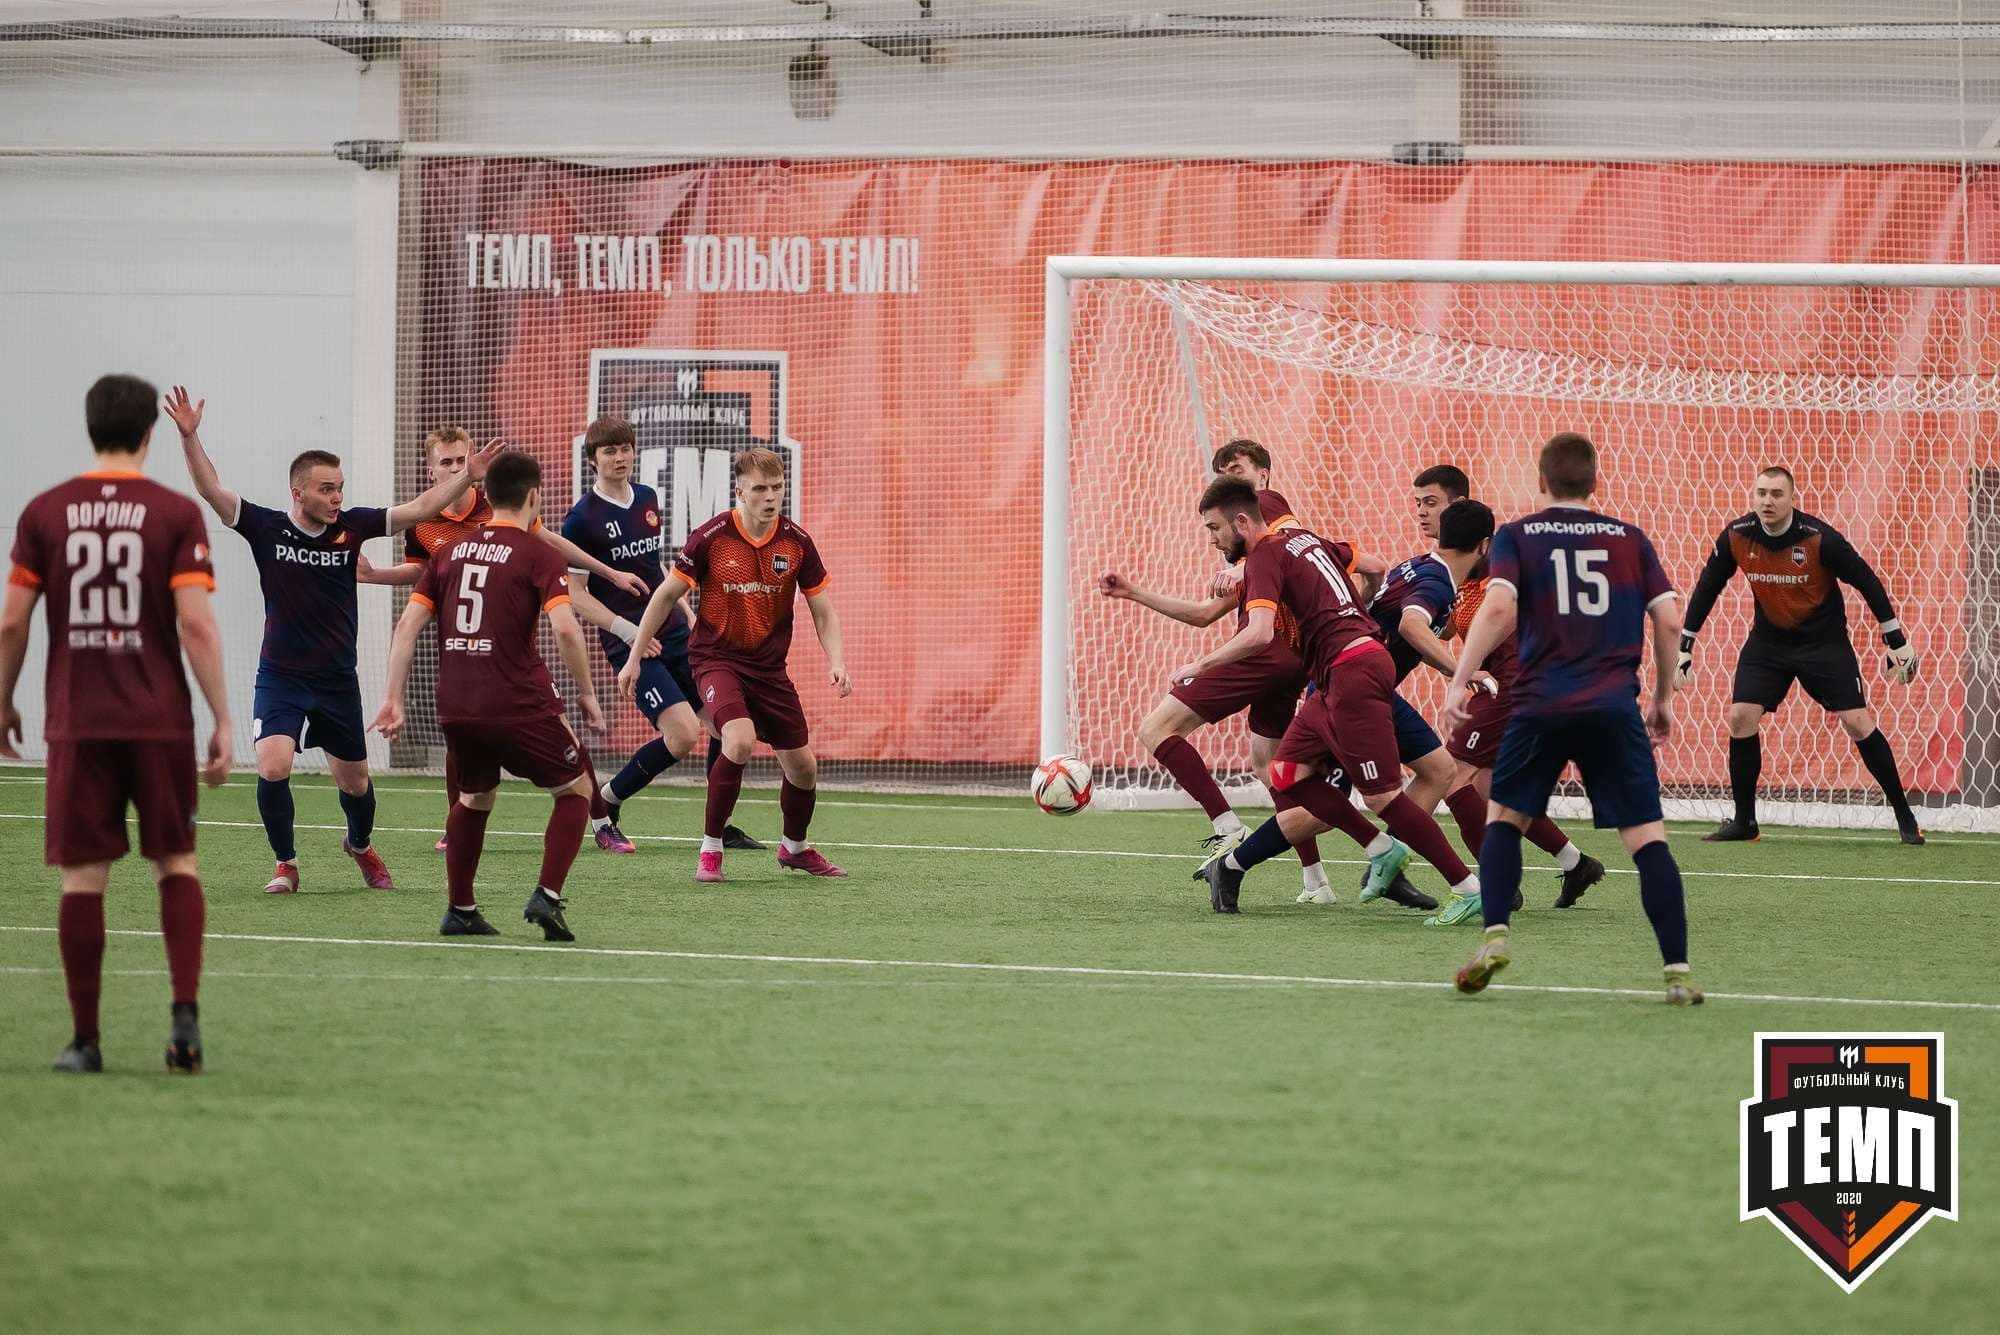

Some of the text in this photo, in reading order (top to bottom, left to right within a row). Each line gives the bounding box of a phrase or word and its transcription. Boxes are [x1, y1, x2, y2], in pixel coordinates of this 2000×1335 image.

[466, 233, 920, 298] ТЕМП, ТЕМП, ТОЛЬКО ТЕМП!
[715, 406, 746, 427] КЛУБ
[66, 502, 147, 530] ВОРОНА
[606, 520, 622, 538] 31
[1523, 521, 1627, 537] КРАСНОЯРСК
[275, 544, 350, 567] РАССВЕТ
[451, 541, 513, 564] БОРИСОВ
[66, 530, 144, 626] 23
[1304, 547, 1353, 606] 10
[1550, 548, 1609, 616] 15
[456, 562, 489, 634] 5
[445, 637, 492, 652] SEUS
[645, 687, 663, 709] 31
[1466, 731, 1480, 749] 8
[1360, 760, 1378, 781] 10
